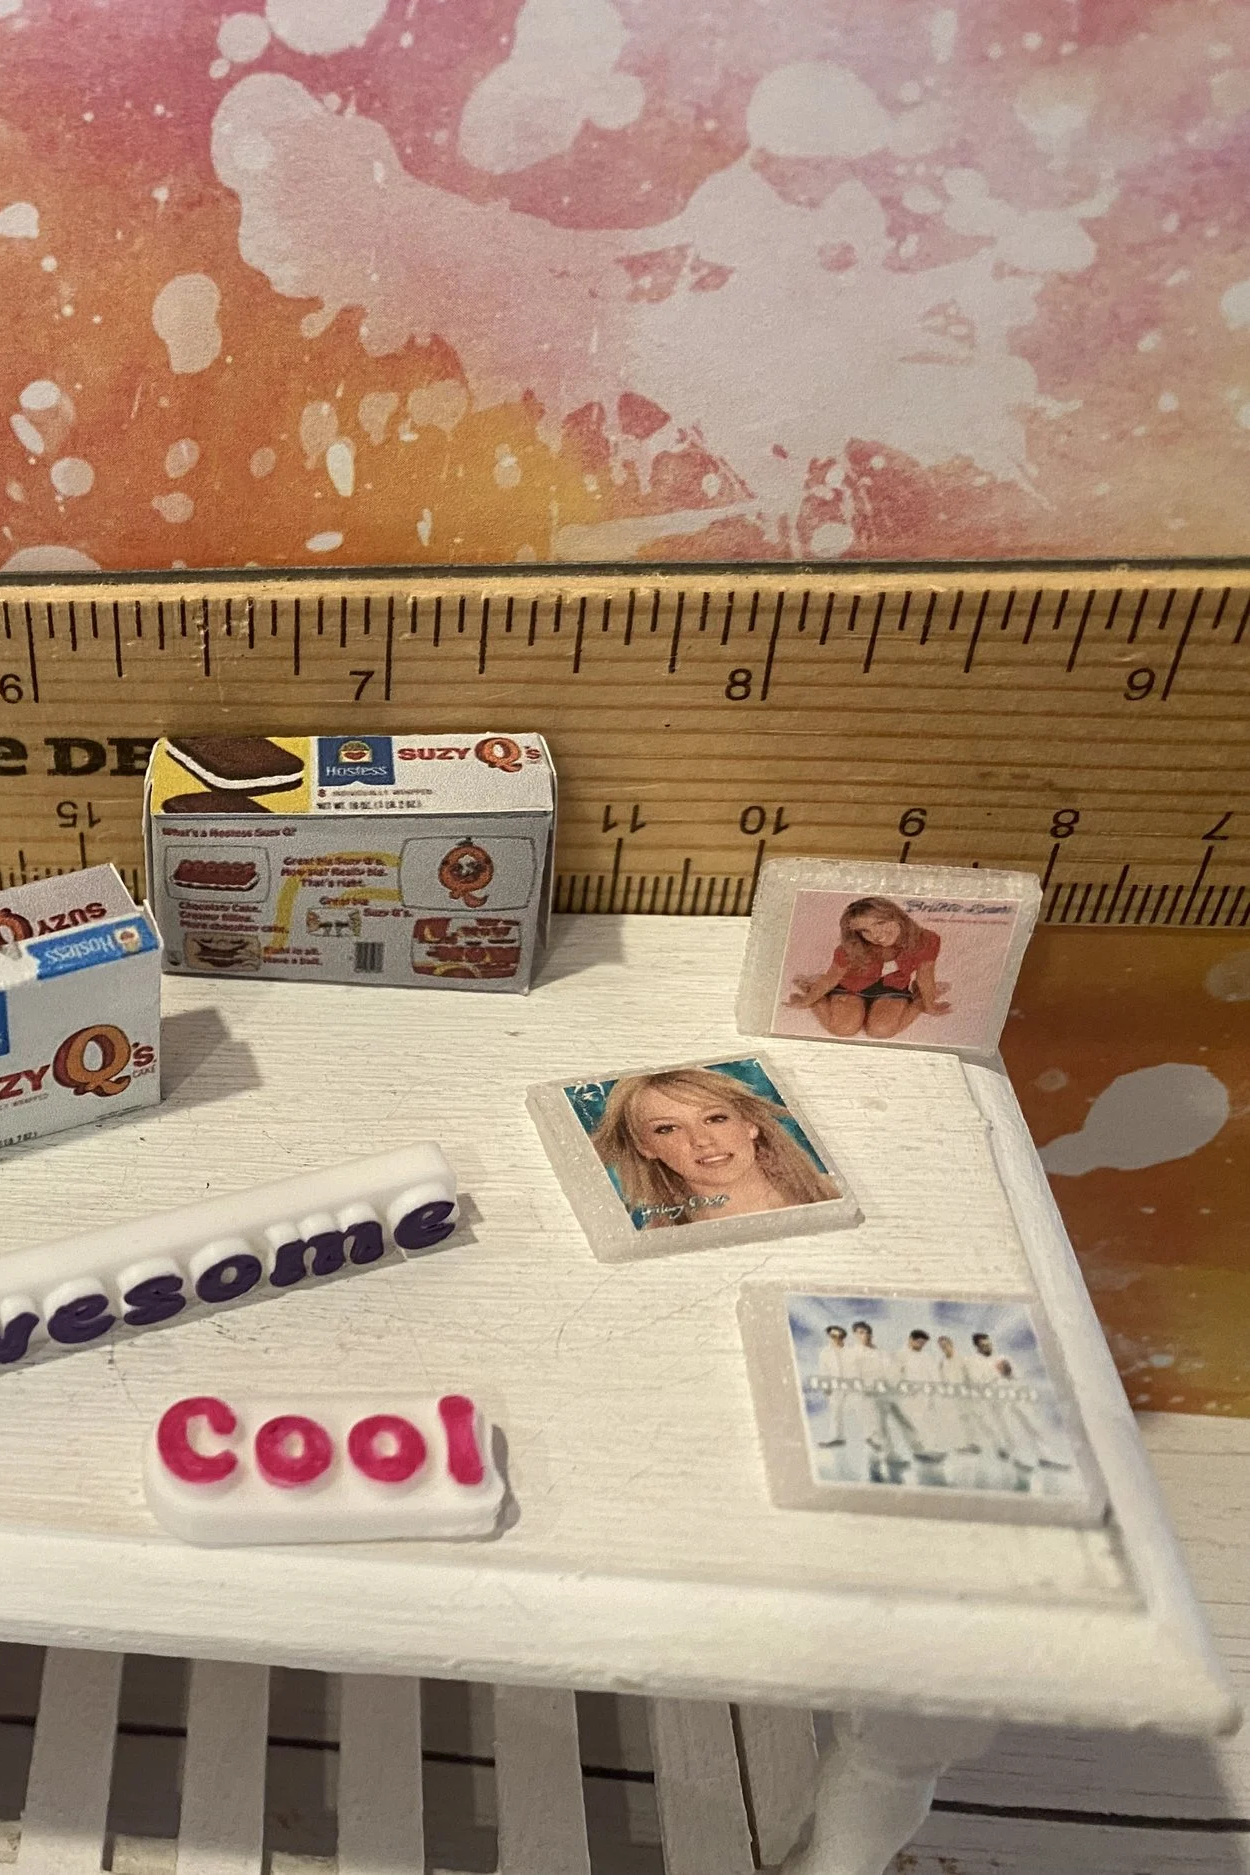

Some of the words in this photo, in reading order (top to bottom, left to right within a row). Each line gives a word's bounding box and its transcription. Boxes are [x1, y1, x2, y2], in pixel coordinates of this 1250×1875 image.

[0, 673, 24, 704] 6
[349, 670, 375, 701] 7
[725, 667, 752, 701] 8
[1124, 667, 1155, 701] 9
[397, 747, 471, 761] SUZY
[157, 1394, 485, 1488] Cool
